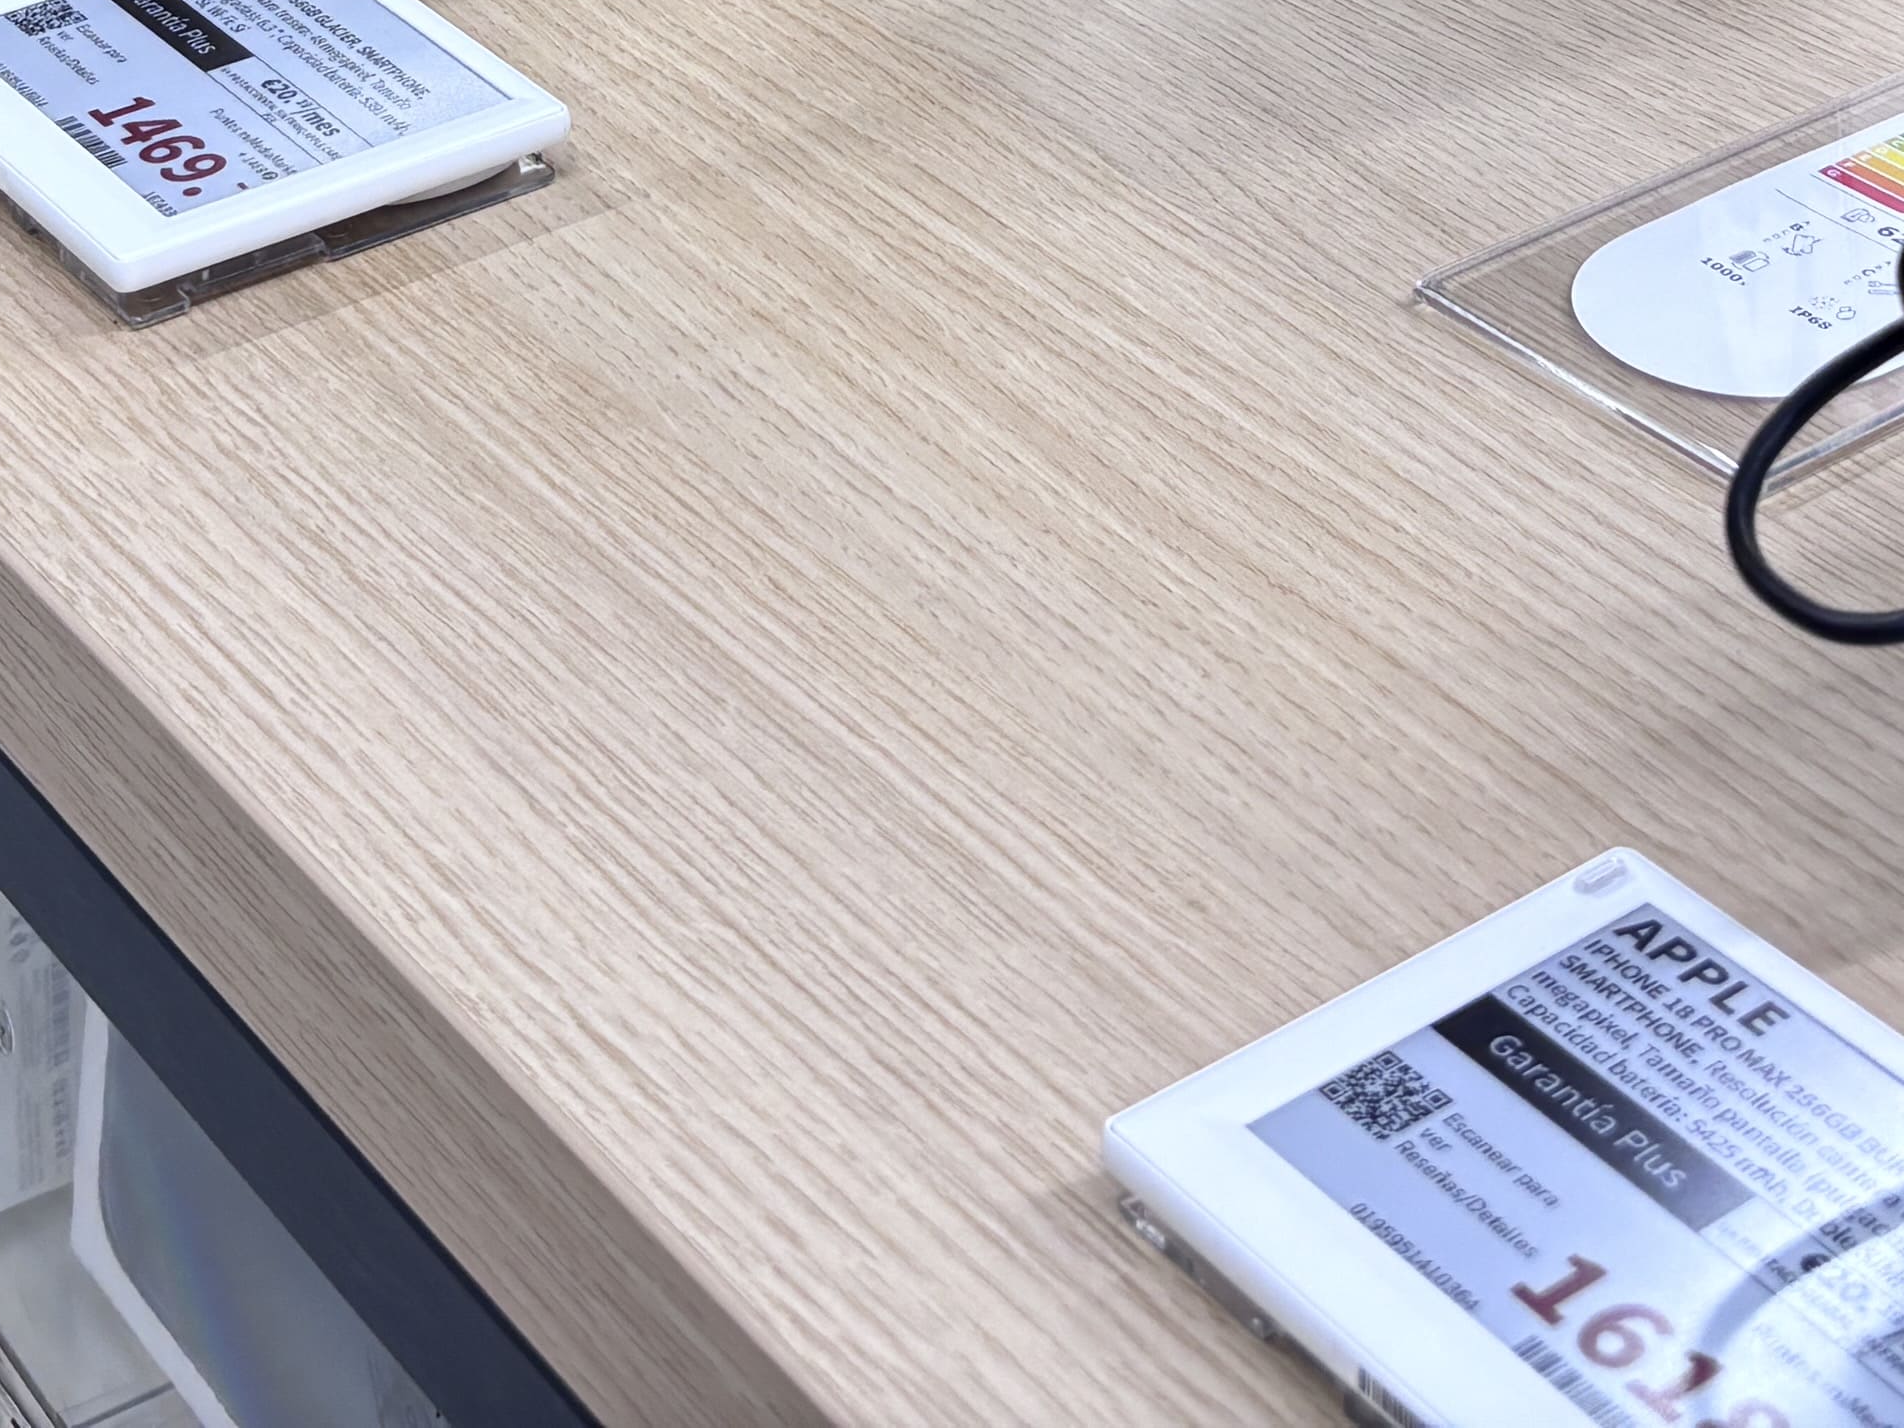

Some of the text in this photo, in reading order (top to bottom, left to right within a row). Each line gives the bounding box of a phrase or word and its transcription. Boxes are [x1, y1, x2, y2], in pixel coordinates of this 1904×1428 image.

[179, 29, 215, 54] Plus
[1584, 940, 1669, 999] IPHONE
[1662, 998, 1695, 1020] 18
[1690, 1015, 1741, 1051] PRO
[1736, 1049, 1790, 1087] MAX
[1613, 920, 1787, 1035] APPLE
[1507, 985, 1616, 1064] Capacidad
[1608, 1059, 1687, 1121] batería:
[1531, 971, 1638, 1050] megapixel,
[1639, 1044, 1719, 1108] Tamaño
[1712, 1108, 1799, 1168] pantalla
[1559, 955, 1702, 1063] SMARTPHONE,
[1703, 1060, 1809, 1139] Resolución
[1417, 1127, 1453, 1154] ver
[1441, 1111, 1560, 1211] Escanear para
[1490, 1036, 1705, 1192] Garantía Plus
[1394, 1139, 1540, 1260] Reseñas/Detalles
